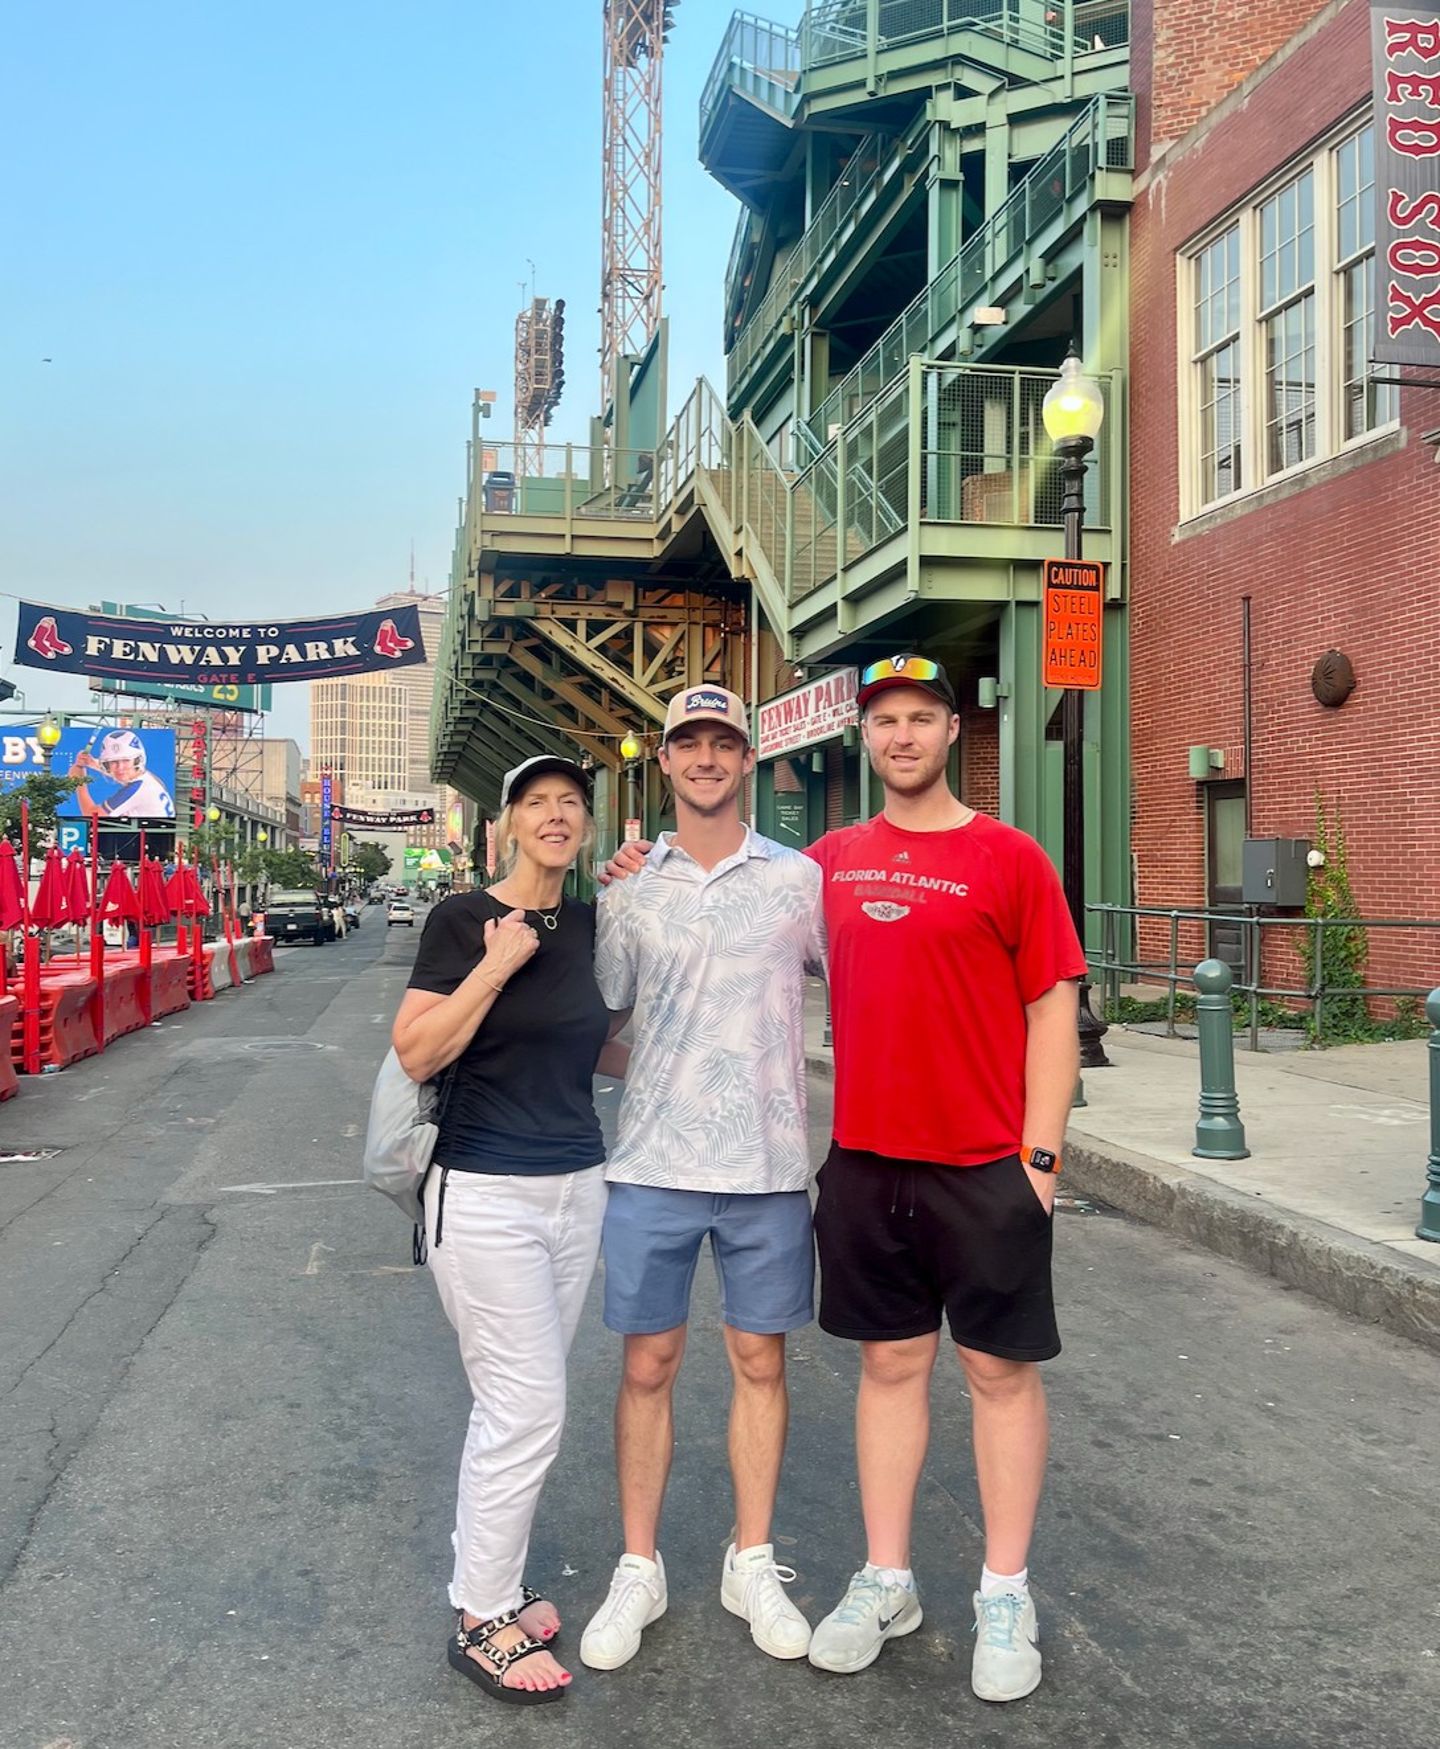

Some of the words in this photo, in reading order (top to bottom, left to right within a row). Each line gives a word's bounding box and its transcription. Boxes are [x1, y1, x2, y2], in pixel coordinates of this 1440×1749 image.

[1384, 16, 1440, 160] RED
[1387, 188, 1440, 342] SOX
[1051, 566, 1096, 587] CAUTION
[1053, 594, 1094, 615] STEEL
[170, 627, 251, 639] WELCOME
[257, 627, 279, 637] TO
[1048, 621, 1097, 642] PLATES
[85, 635, 247, 667] FENWAY
[256, 636, 361, 665] PARK
[1048, 647, 1097, 668] AHEAD
[197, 673, 239, 684] GATE
[247, 673, 257, 683] E
[687, 694, 727, 709] Bruins
[760, 689, 812, 735] FENWAY
[814, 669, 859, 714] PARK
[2, 736, 45, 765] BY
[191, 720, 207, 779] GATE
[346, 812, 387, 823] FENWAY
[389, 814, 418, 823] PARK
[61, 827, 80, 850] P
[831, 869, 887, 882] FLORIDA
[889, 871, 969, 897] ATLANTIC
